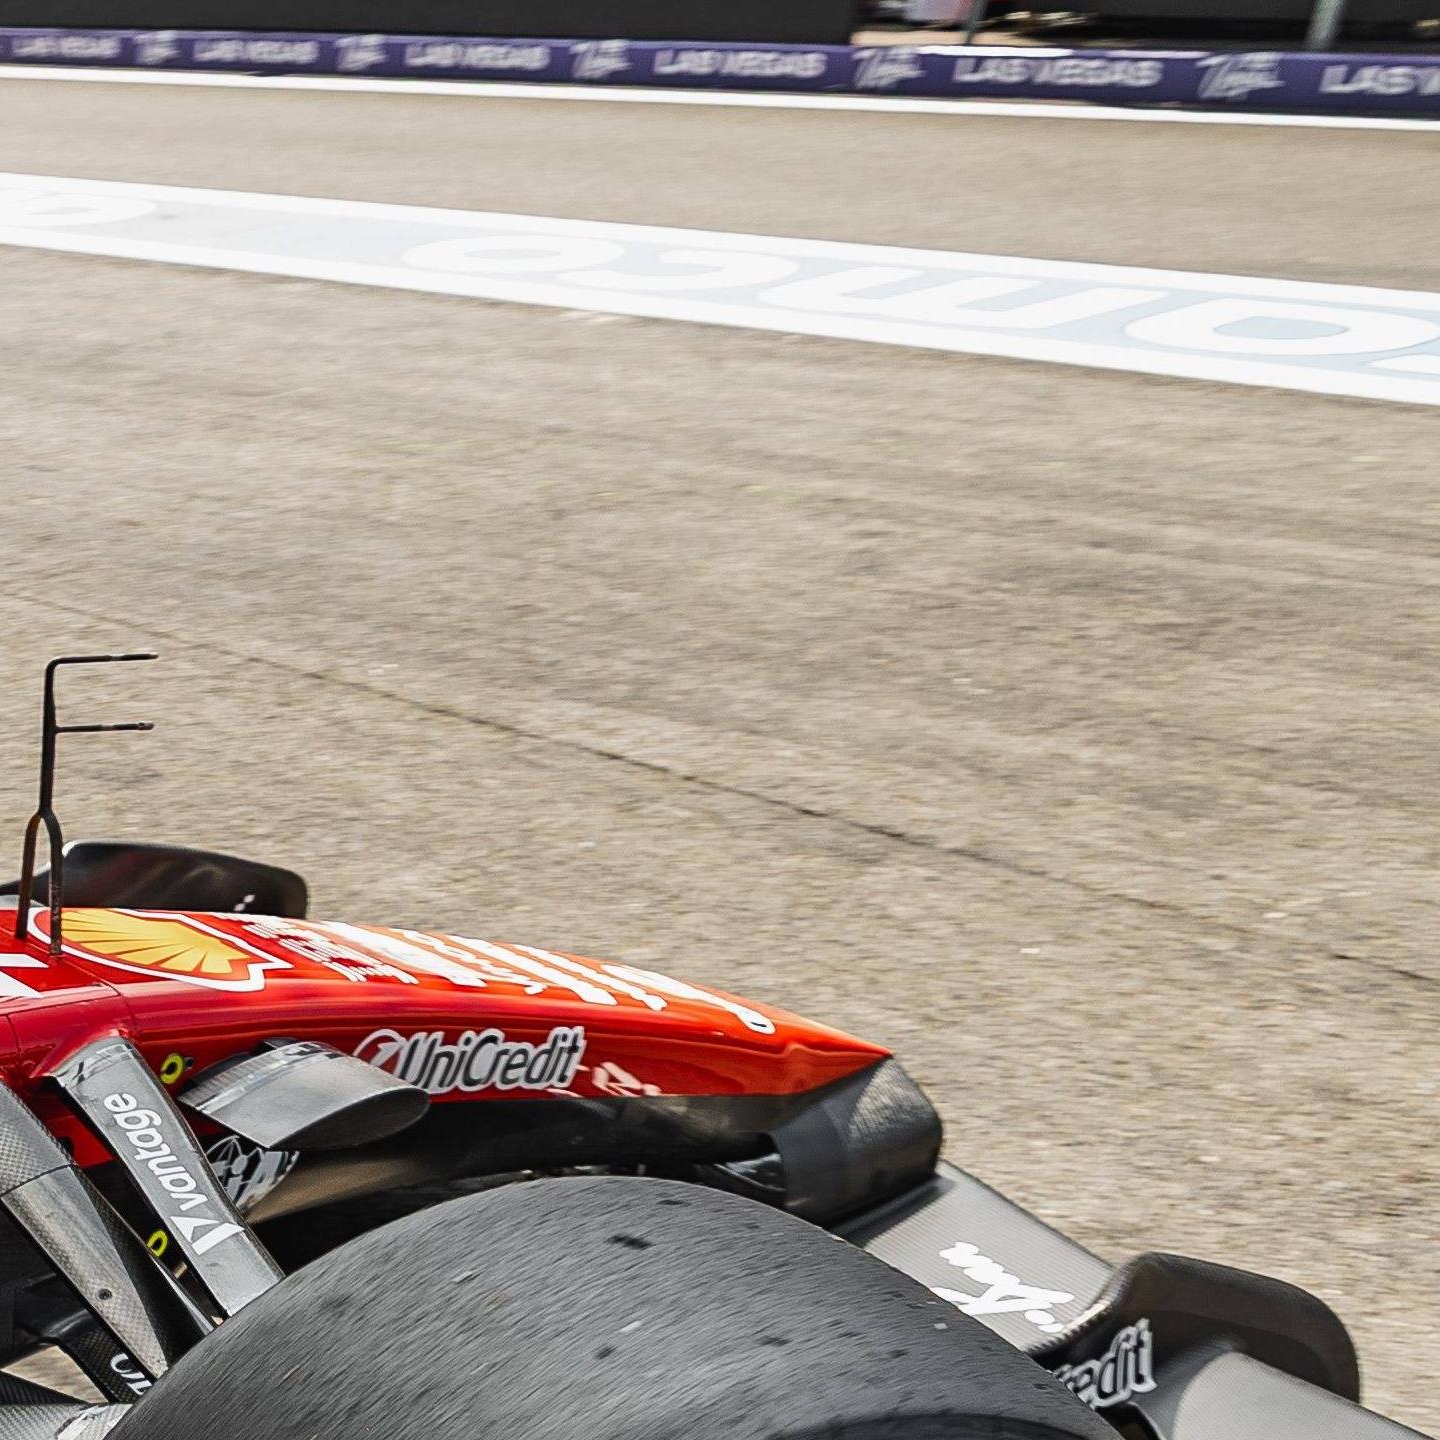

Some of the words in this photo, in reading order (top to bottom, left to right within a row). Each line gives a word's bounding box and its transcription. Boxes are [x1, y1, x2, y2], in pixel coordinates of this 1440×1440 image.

[405, 43, 461, 68] LAS
[653, 50, 719, 75] LAS
[719, 51, 826, 78] VEGAS
[953, 57, 1031, 84] LAS
[1032, 59, 1163, 87] VEGAS
[1319, 64, 1416, 96] LAS
[397, 1026, 585, 1092] UniCredit
